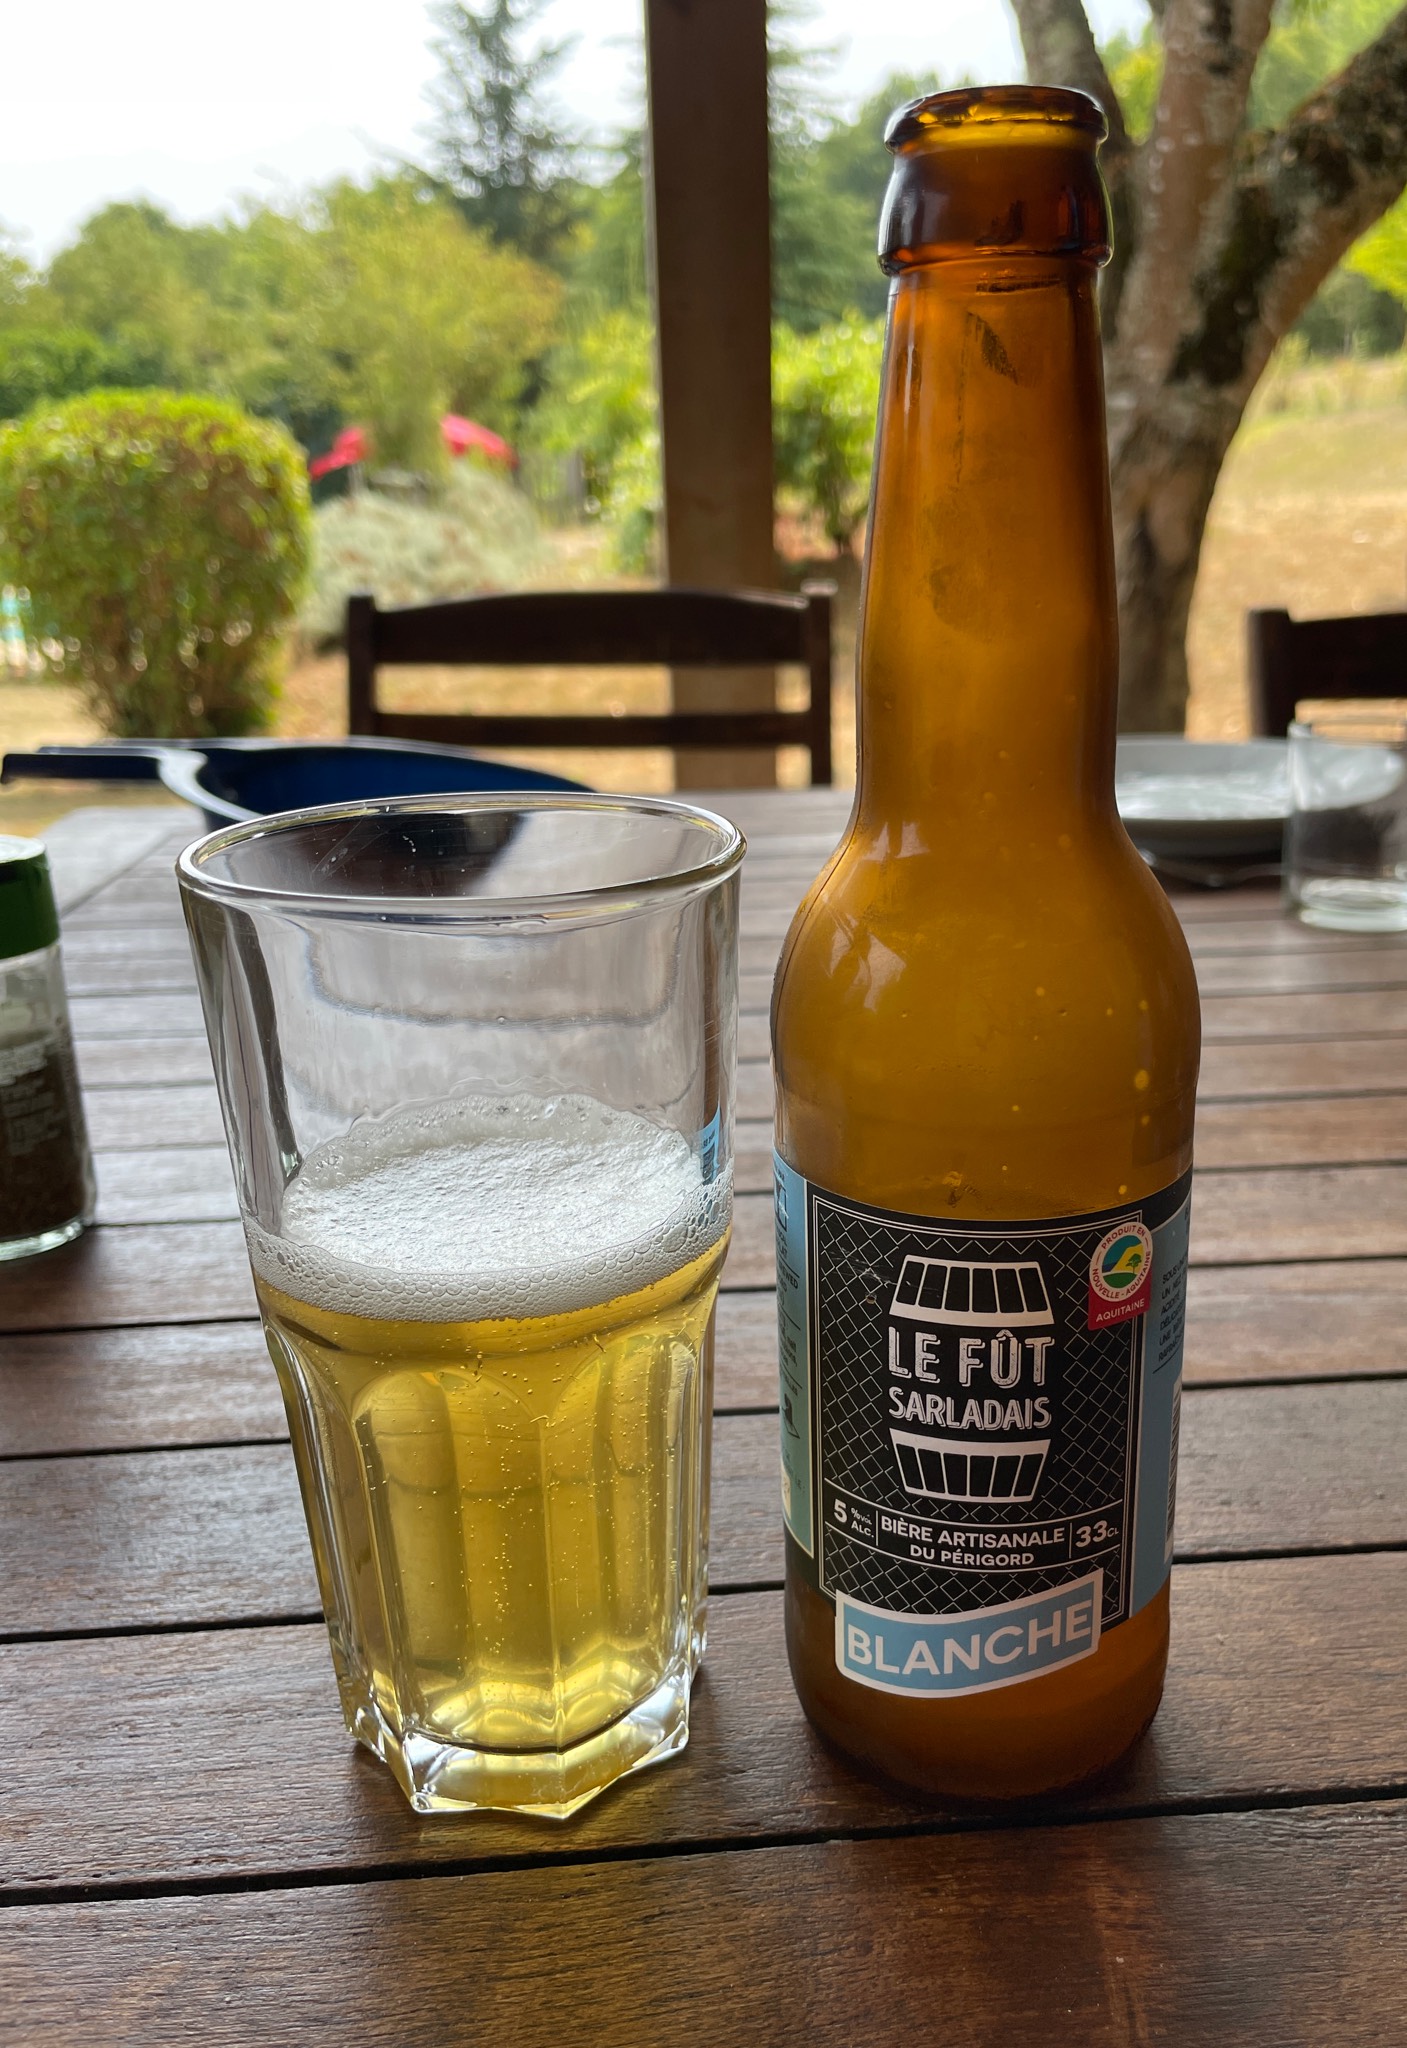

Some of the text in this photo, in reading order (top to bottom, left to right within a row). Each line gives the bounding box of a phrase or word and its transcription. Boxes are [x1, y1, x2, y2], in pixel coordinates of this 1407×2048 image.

[1101, 1225, 1145, 1249] PRODUIT EN
[1092, 1268, 1120, 1299] NOUVELLE
[1126, 1251, 1151, 1296] AQUITAINE
[1095, 1298, 1145, 1323] AQUITAINE
[887, 1326, 1055, 1389] LE FÛT
[888, 1386, 1052, 1431] SARLADAIS
[833, 1498, 848, 1523] 5
[881, 1514, 1065, 1549] BIÈRE ARTISANALE
[910, 1544, 1035, 1567] DU PÉRIGORD
[847, 1600, 1092, 1676] BLANCHE
